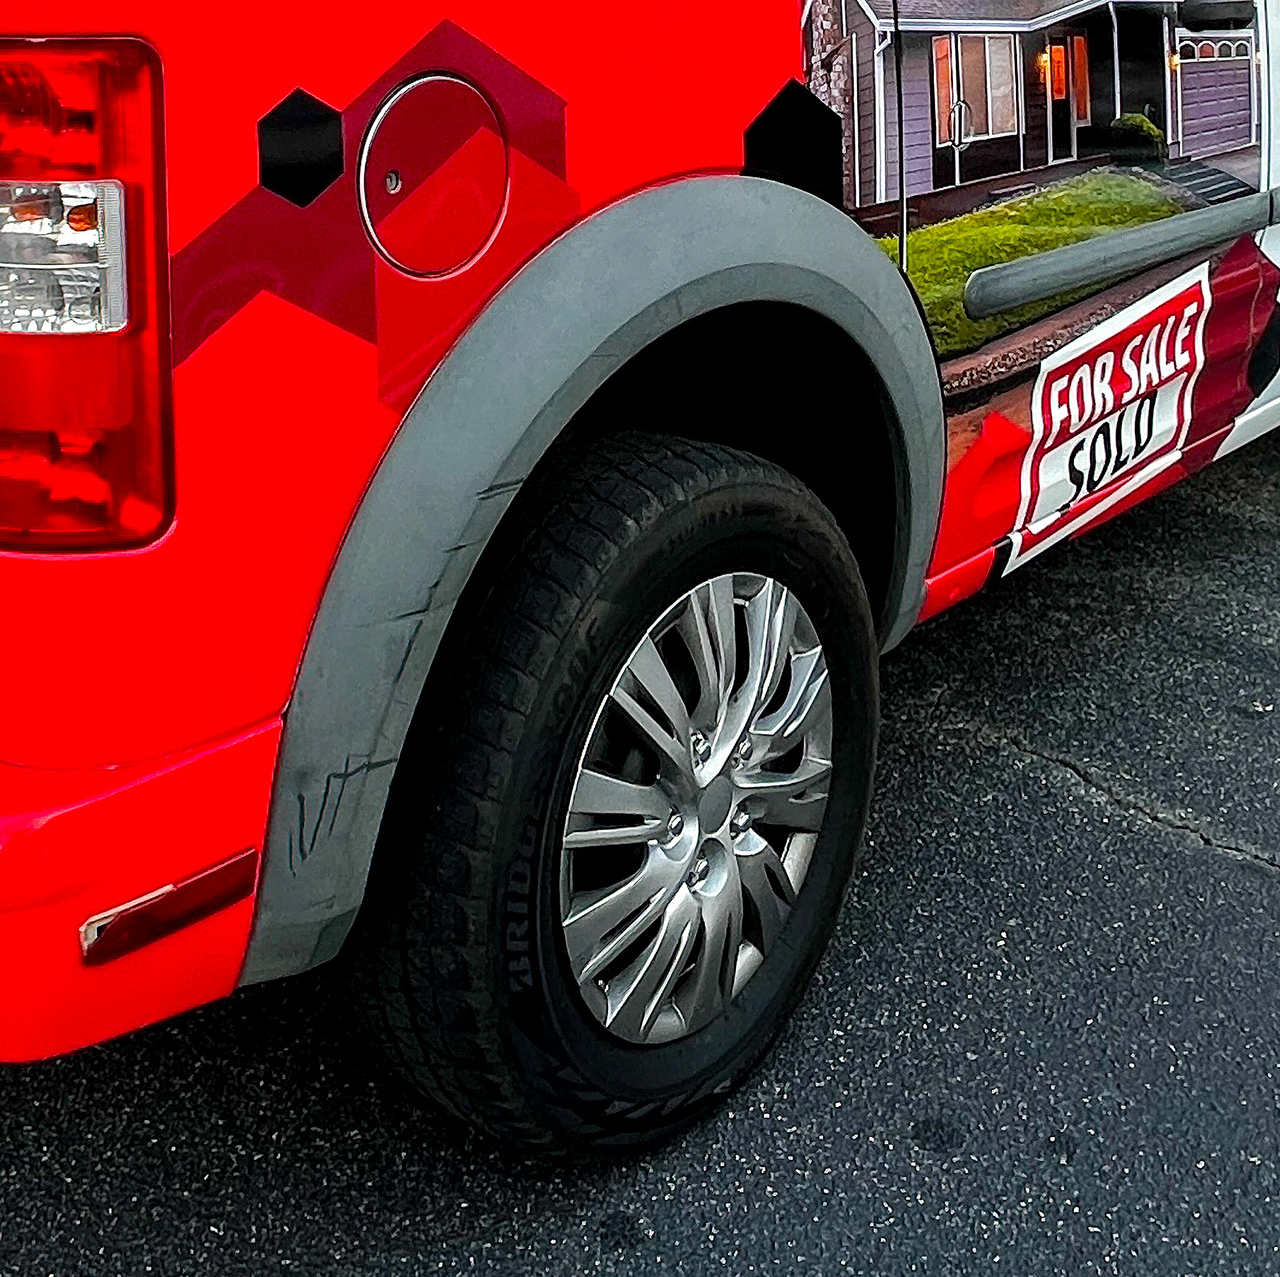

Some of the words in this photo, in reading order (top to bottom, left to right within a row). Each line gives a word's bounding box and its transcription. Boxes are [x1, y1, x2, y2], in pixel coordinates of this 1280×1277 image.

[1045, 351, 1115, 447] FOR
[1121, 301, 1198, 401] SALE
[1060, 391, 1158, 508] SOLD
